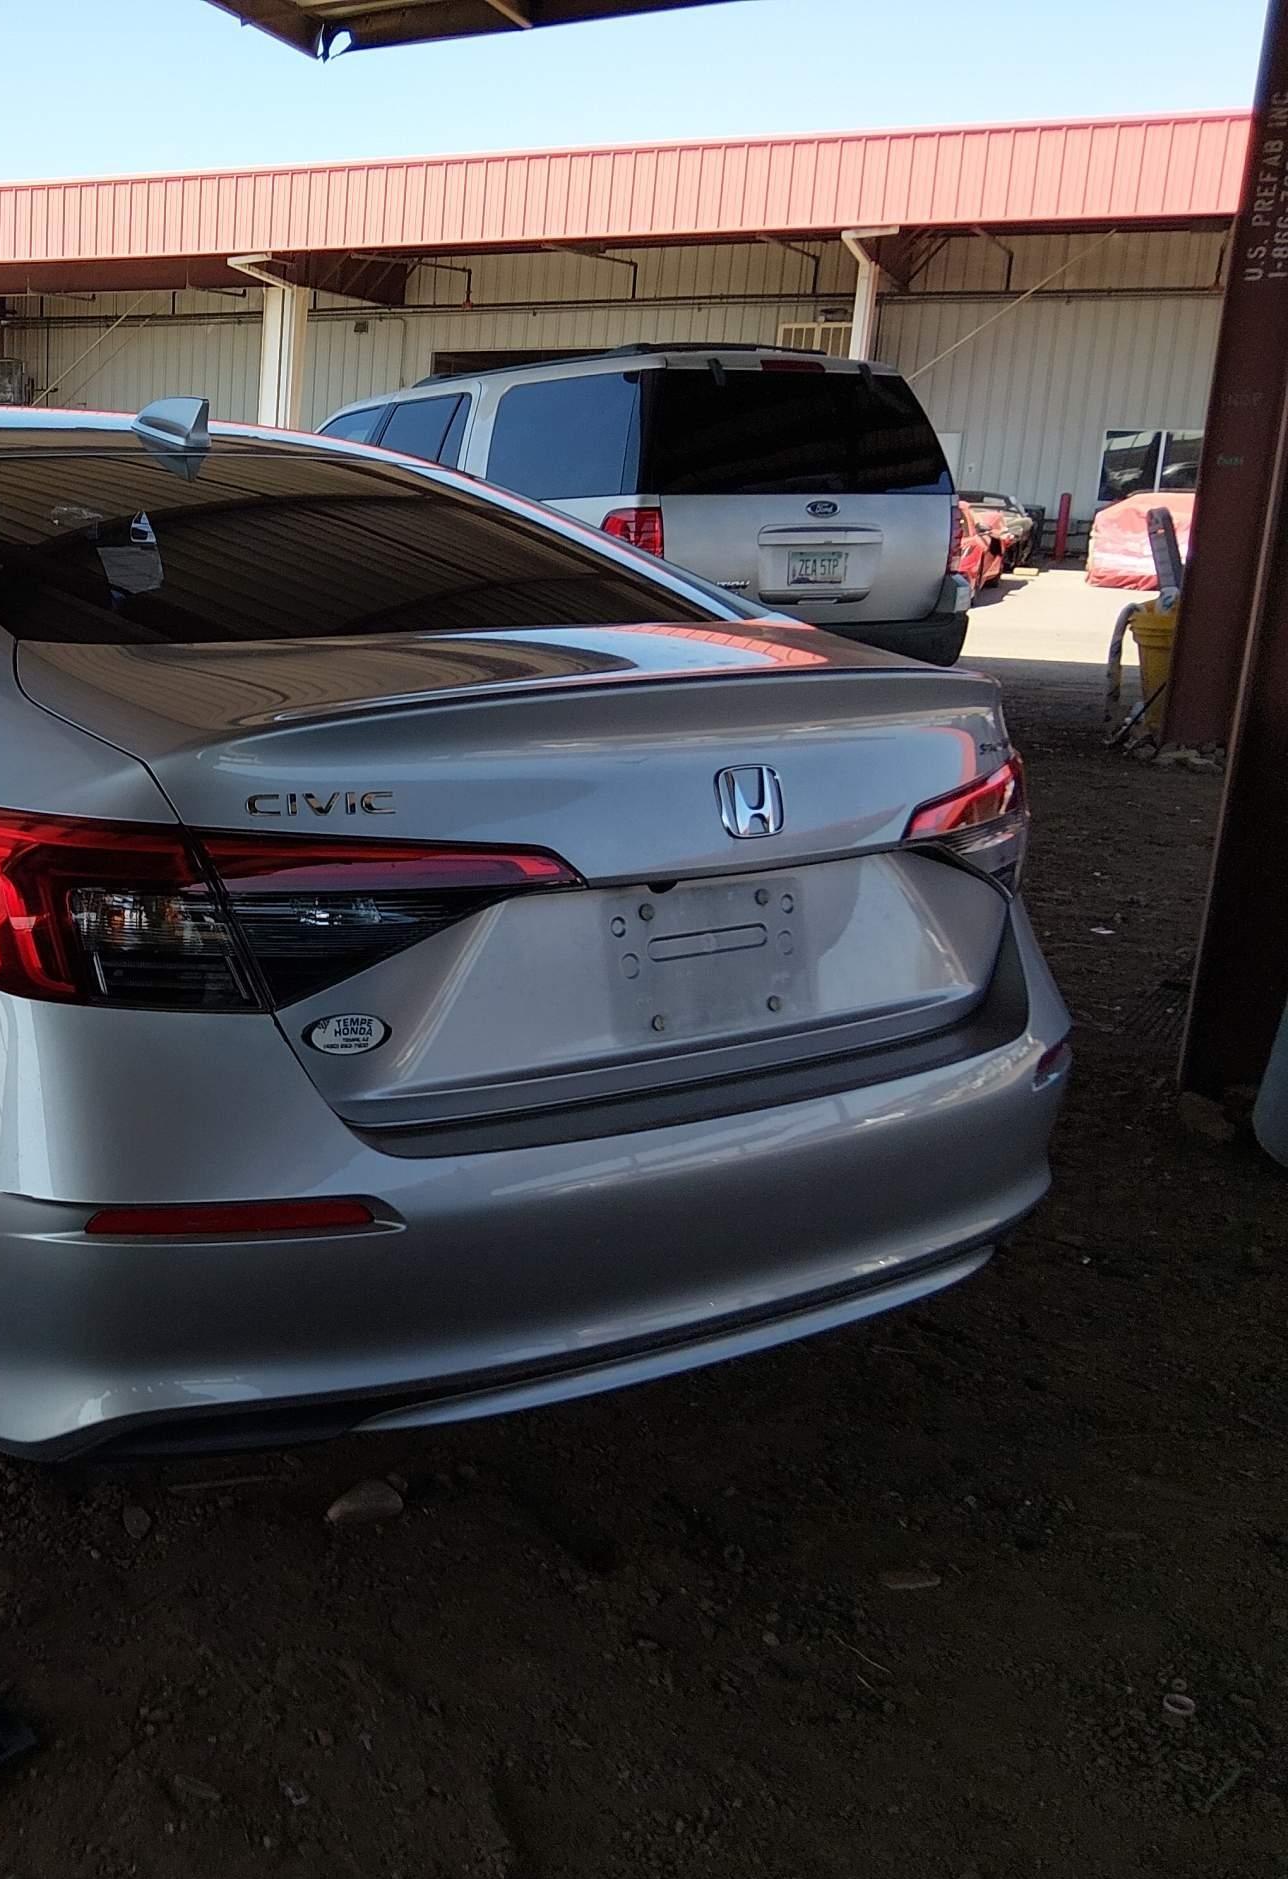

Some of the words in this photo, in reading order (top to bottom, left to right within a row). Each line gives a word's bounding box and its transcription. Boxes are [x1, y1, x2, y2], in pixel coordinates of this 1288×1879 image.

[1252, 139, 1284, 227] PREFAB
[1244, 239, 1269, 281] U.S.
[245, 791, 396, 816] CIVIC
[334, 1026, 373, 1037] HONDA
[336, 1017, 374, 1028] TEMPE
